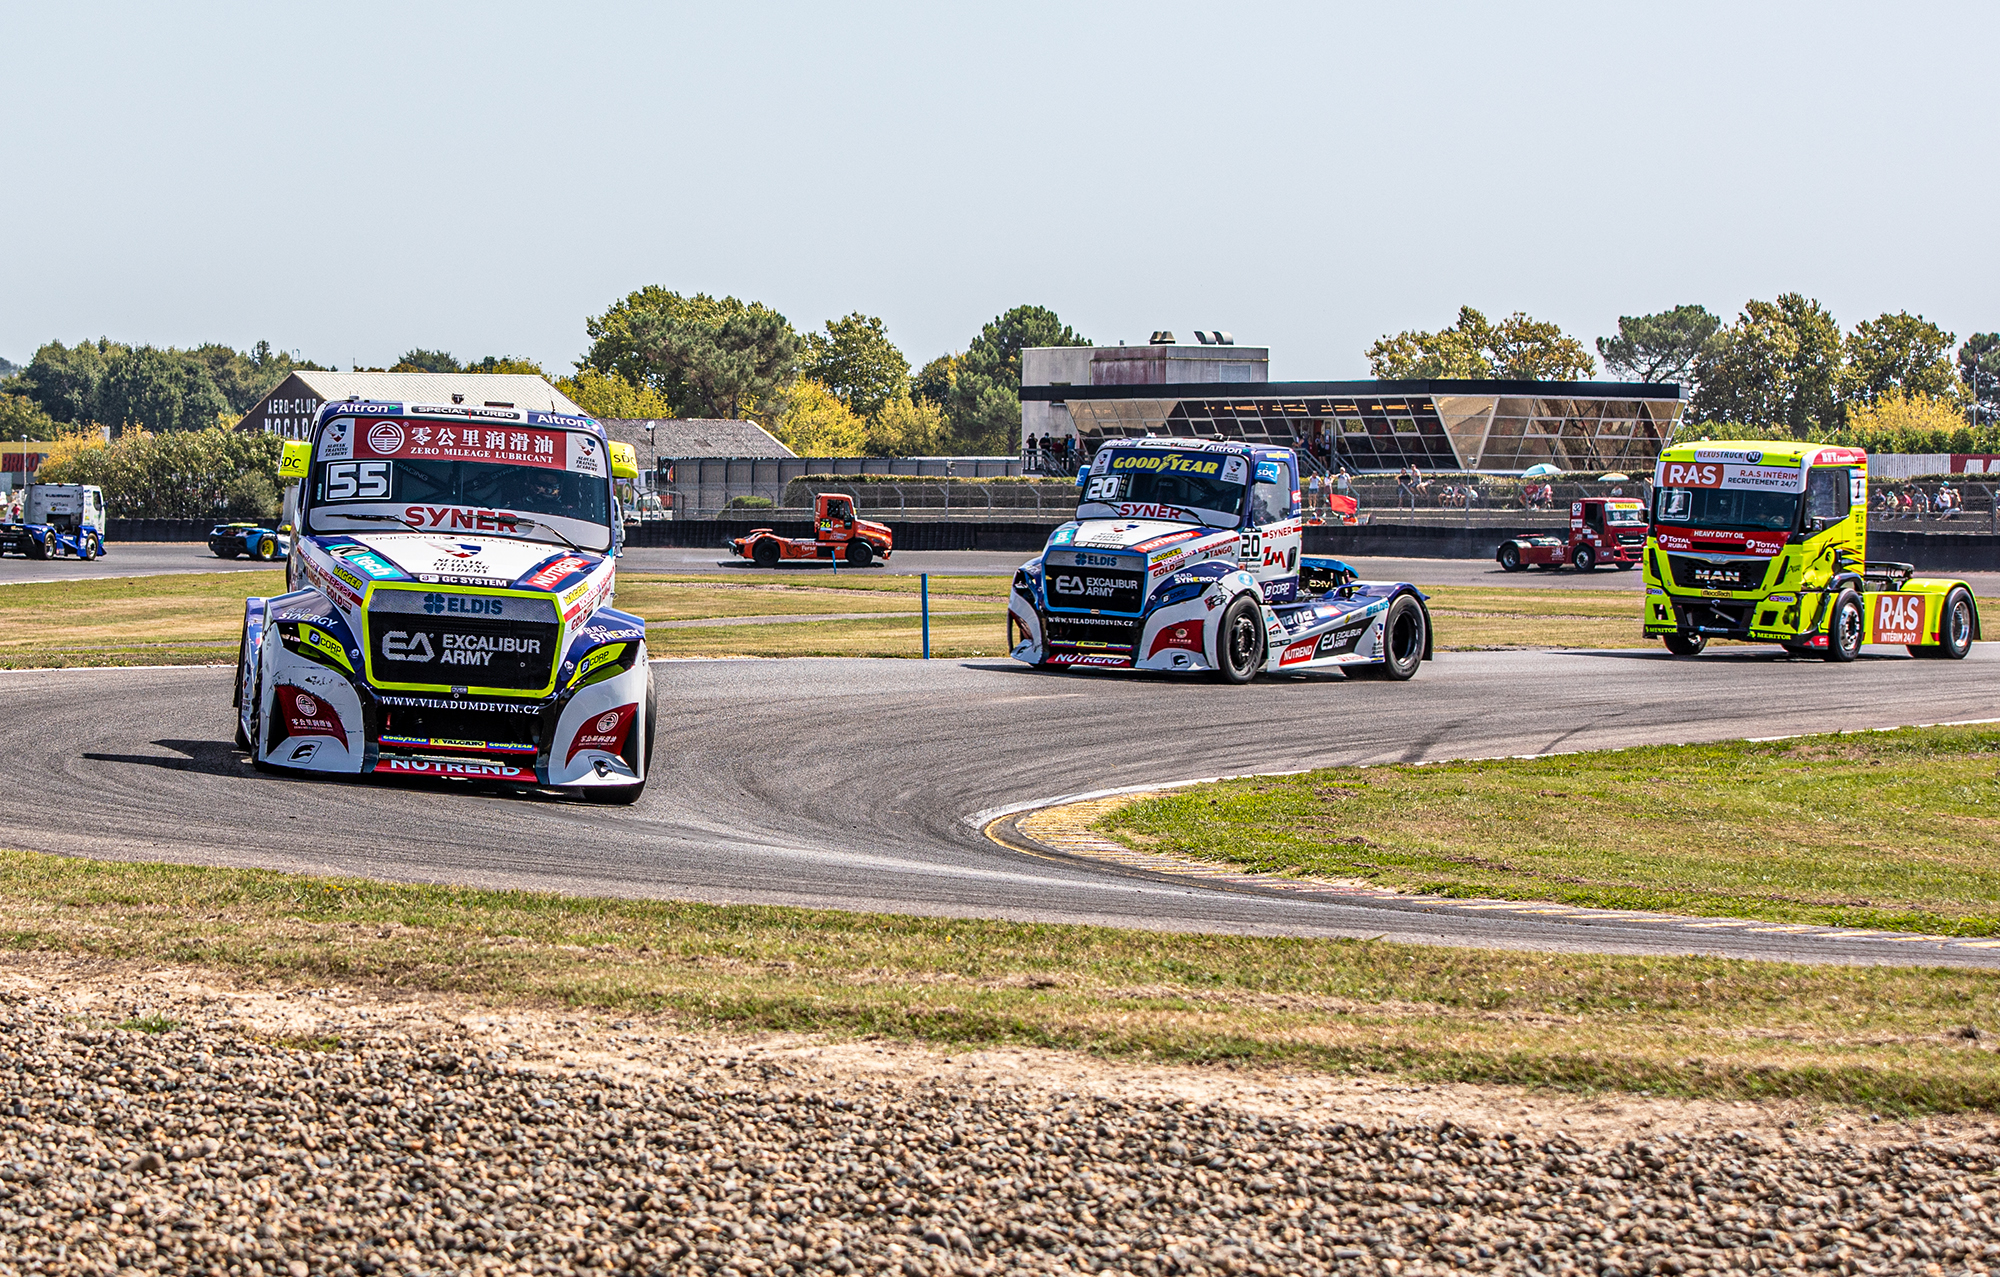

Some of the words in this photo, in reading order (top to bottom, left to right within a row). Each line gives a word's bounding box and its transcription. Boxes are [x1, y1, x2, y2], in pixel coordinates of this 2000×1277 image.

[267, 398, 317, 414] AERO-CLUB
[336, 403, 389, 414] Altron
[417, 406, 466, 415] SPECIAL
[475, 410, 515, 418] TURBO
[537, 413, 588, 428] Altron
[411, 426, 554, 455] 零公里润滑油
[1103, 439, 1132, 448] Altron
[410, 446, 440, 456] ZERO
[443, 449, 491, 459] MILEAGE
[495, 451, 554, 464] LUBRICANT
[1206, 444, 1243, 455] Altron
[1697, 451, 1744, 460] NEXUSTRUCK
[2, 452, 40, 473] BRICO
[329, 462, 388, 499] 55
[1739, 469, 1762, 478] R.A.S
[1762, 471, 1799, 481] INTÉRIM
[1087, 477, 1119, 499] 20
[1727, 477, 1780, 487] RECRUTEMENT
[1779, 480, 1799, 489] 24/7
[1854, 479, 1861, 499] 1
[1573, 503, 1582, 512] 32
[1667, 494, 1684, 514] 1
[1119, 503, 1183, 520] SYNER
[404, 506, 519, 534] SYNER
[820, 521, 831, 529] 26
[1268, 526, 1292, 540] SYNER
[1693, 530, 1714, 538] HEAVY
[1714, 531, 1734, 539] DUTY
[1733, 532, 1745, 540] OIL
[1099, 543, 1125, 551] SYSTEM
[1140, 532, 1194, 551] NUTREND
[1240, 534, 1261, 557] 20
[1209, 545, 1233, 559] TANGO
[352, 555, 391, 578] tech
[1087, 554, 1118, 567] ELDIS
[533, 556, 584, 588] NUTREND
[1152, 563, 1176, 578] GOLD
[1694, 569, 1741, 582] MAN
[441, 576, 458, 584] GC
[459, 577, 508, 588] SYSTEM
[1085, 577, 1139, 590] EXCALIBUR
[1174, 576, 1219, 584] SYNERGY
[1085, 588, 1115, 598] ARMY
[1271, 582, 1290, 595] CORP
[447, 598, 504, 616] ELDIS
[1373, 600, 1390, 614] ELDIS
[1047, 616, 1134, 628] WWW.VILADUMDEVIN.CZ
[583, 625, 608, 635] BUILD
[1336, 628, 1363, 640] EXCALIBUR
[1756, 632, 1792, 640] MERITOR
[1880, 631, 1904, 643] INTÉRIM
[1903, 632, 1917, 643] 24/7
[320, 638, 342, 654] CORP
[442, 633, 541, 654] EXCALIBUR
[440, 650, 495, 667] ARMY
[589, 650, 610, 667] CORP
[1054, 653, 1127, 666] NUTREND
[1283, 645, 1313, 662] NUTREND
[381, 695, 541, 716] WWW.VILADUMDEVIN.CZ
[390, 759, 522, 777] NUTREND
